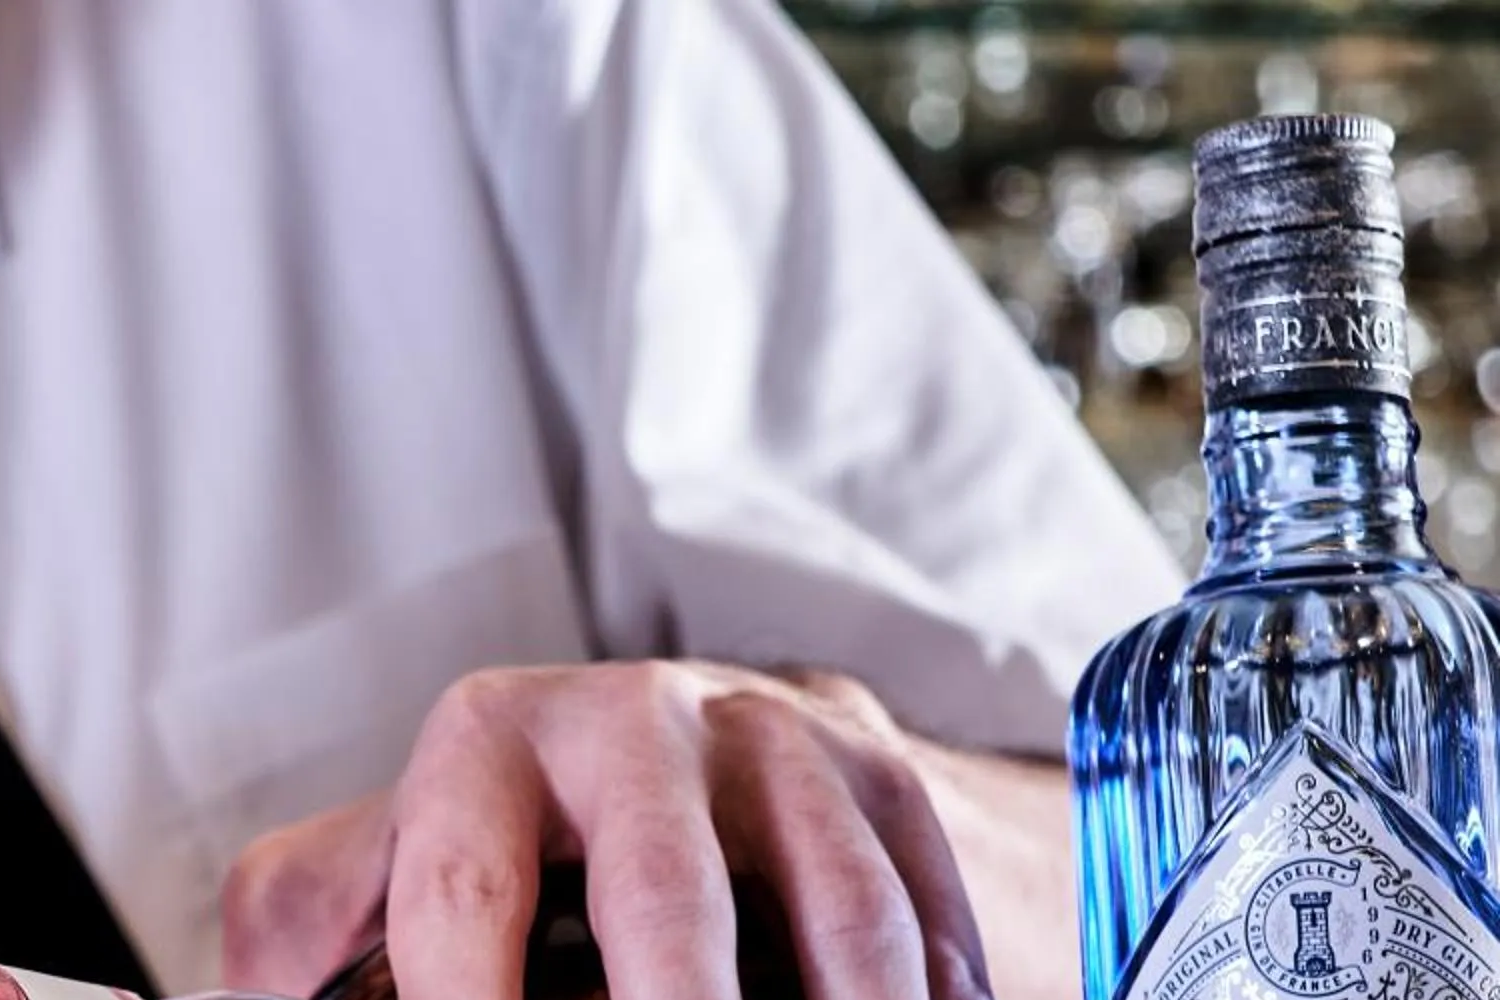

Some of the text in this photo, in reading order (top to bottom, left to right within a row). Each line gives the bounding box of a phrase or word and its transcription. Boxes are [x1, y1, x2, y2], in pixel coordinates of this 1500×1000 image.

[1258, 863, 1337, 908] CITADELLE
[1391, 918, 1479, 980] DRY GIN
[1278, 973, 1341, 992] FRANCE
